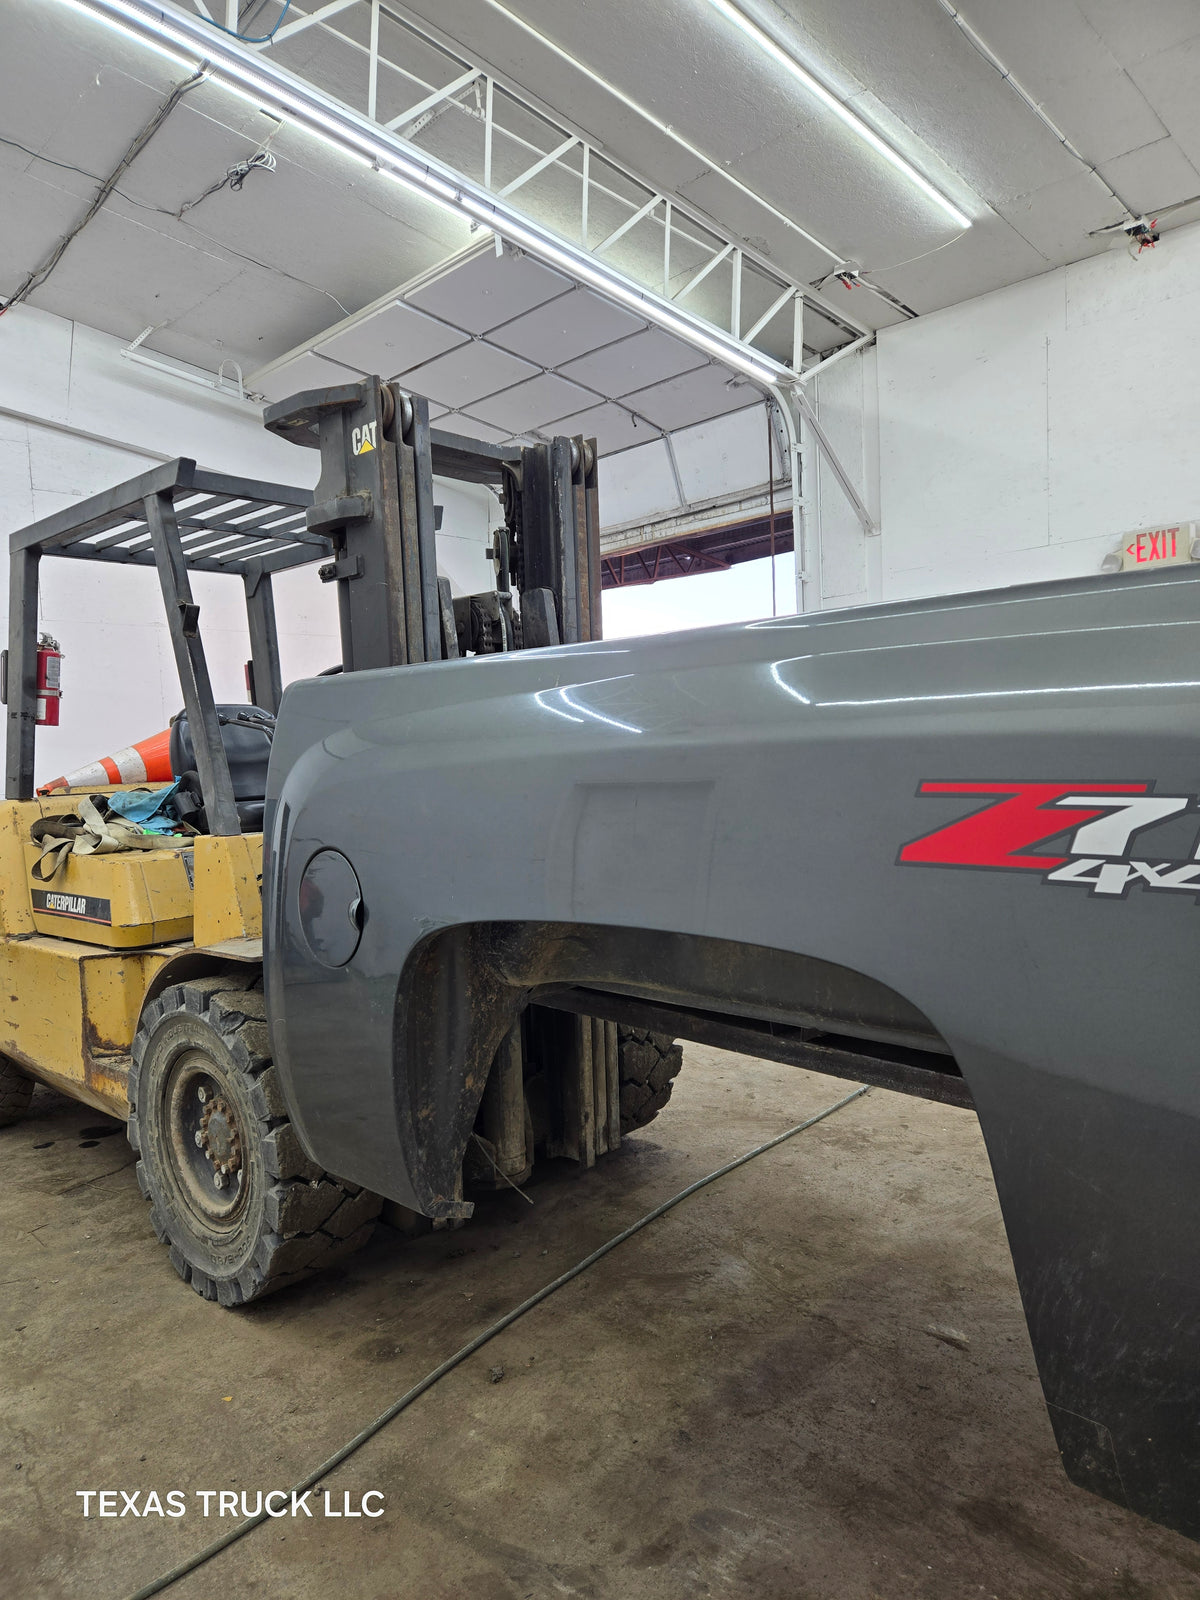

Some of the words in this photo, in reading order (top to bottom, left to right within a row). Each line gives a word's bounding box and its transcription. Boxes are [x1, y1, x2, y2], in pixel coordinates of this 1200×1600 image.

[352, 420, 377, 456] CAT
[1136, 527, 1180, 564] EXIT
[898, 781, 1200, 871] Z7
[46, 893, 87, 915] CATERPILLAR
